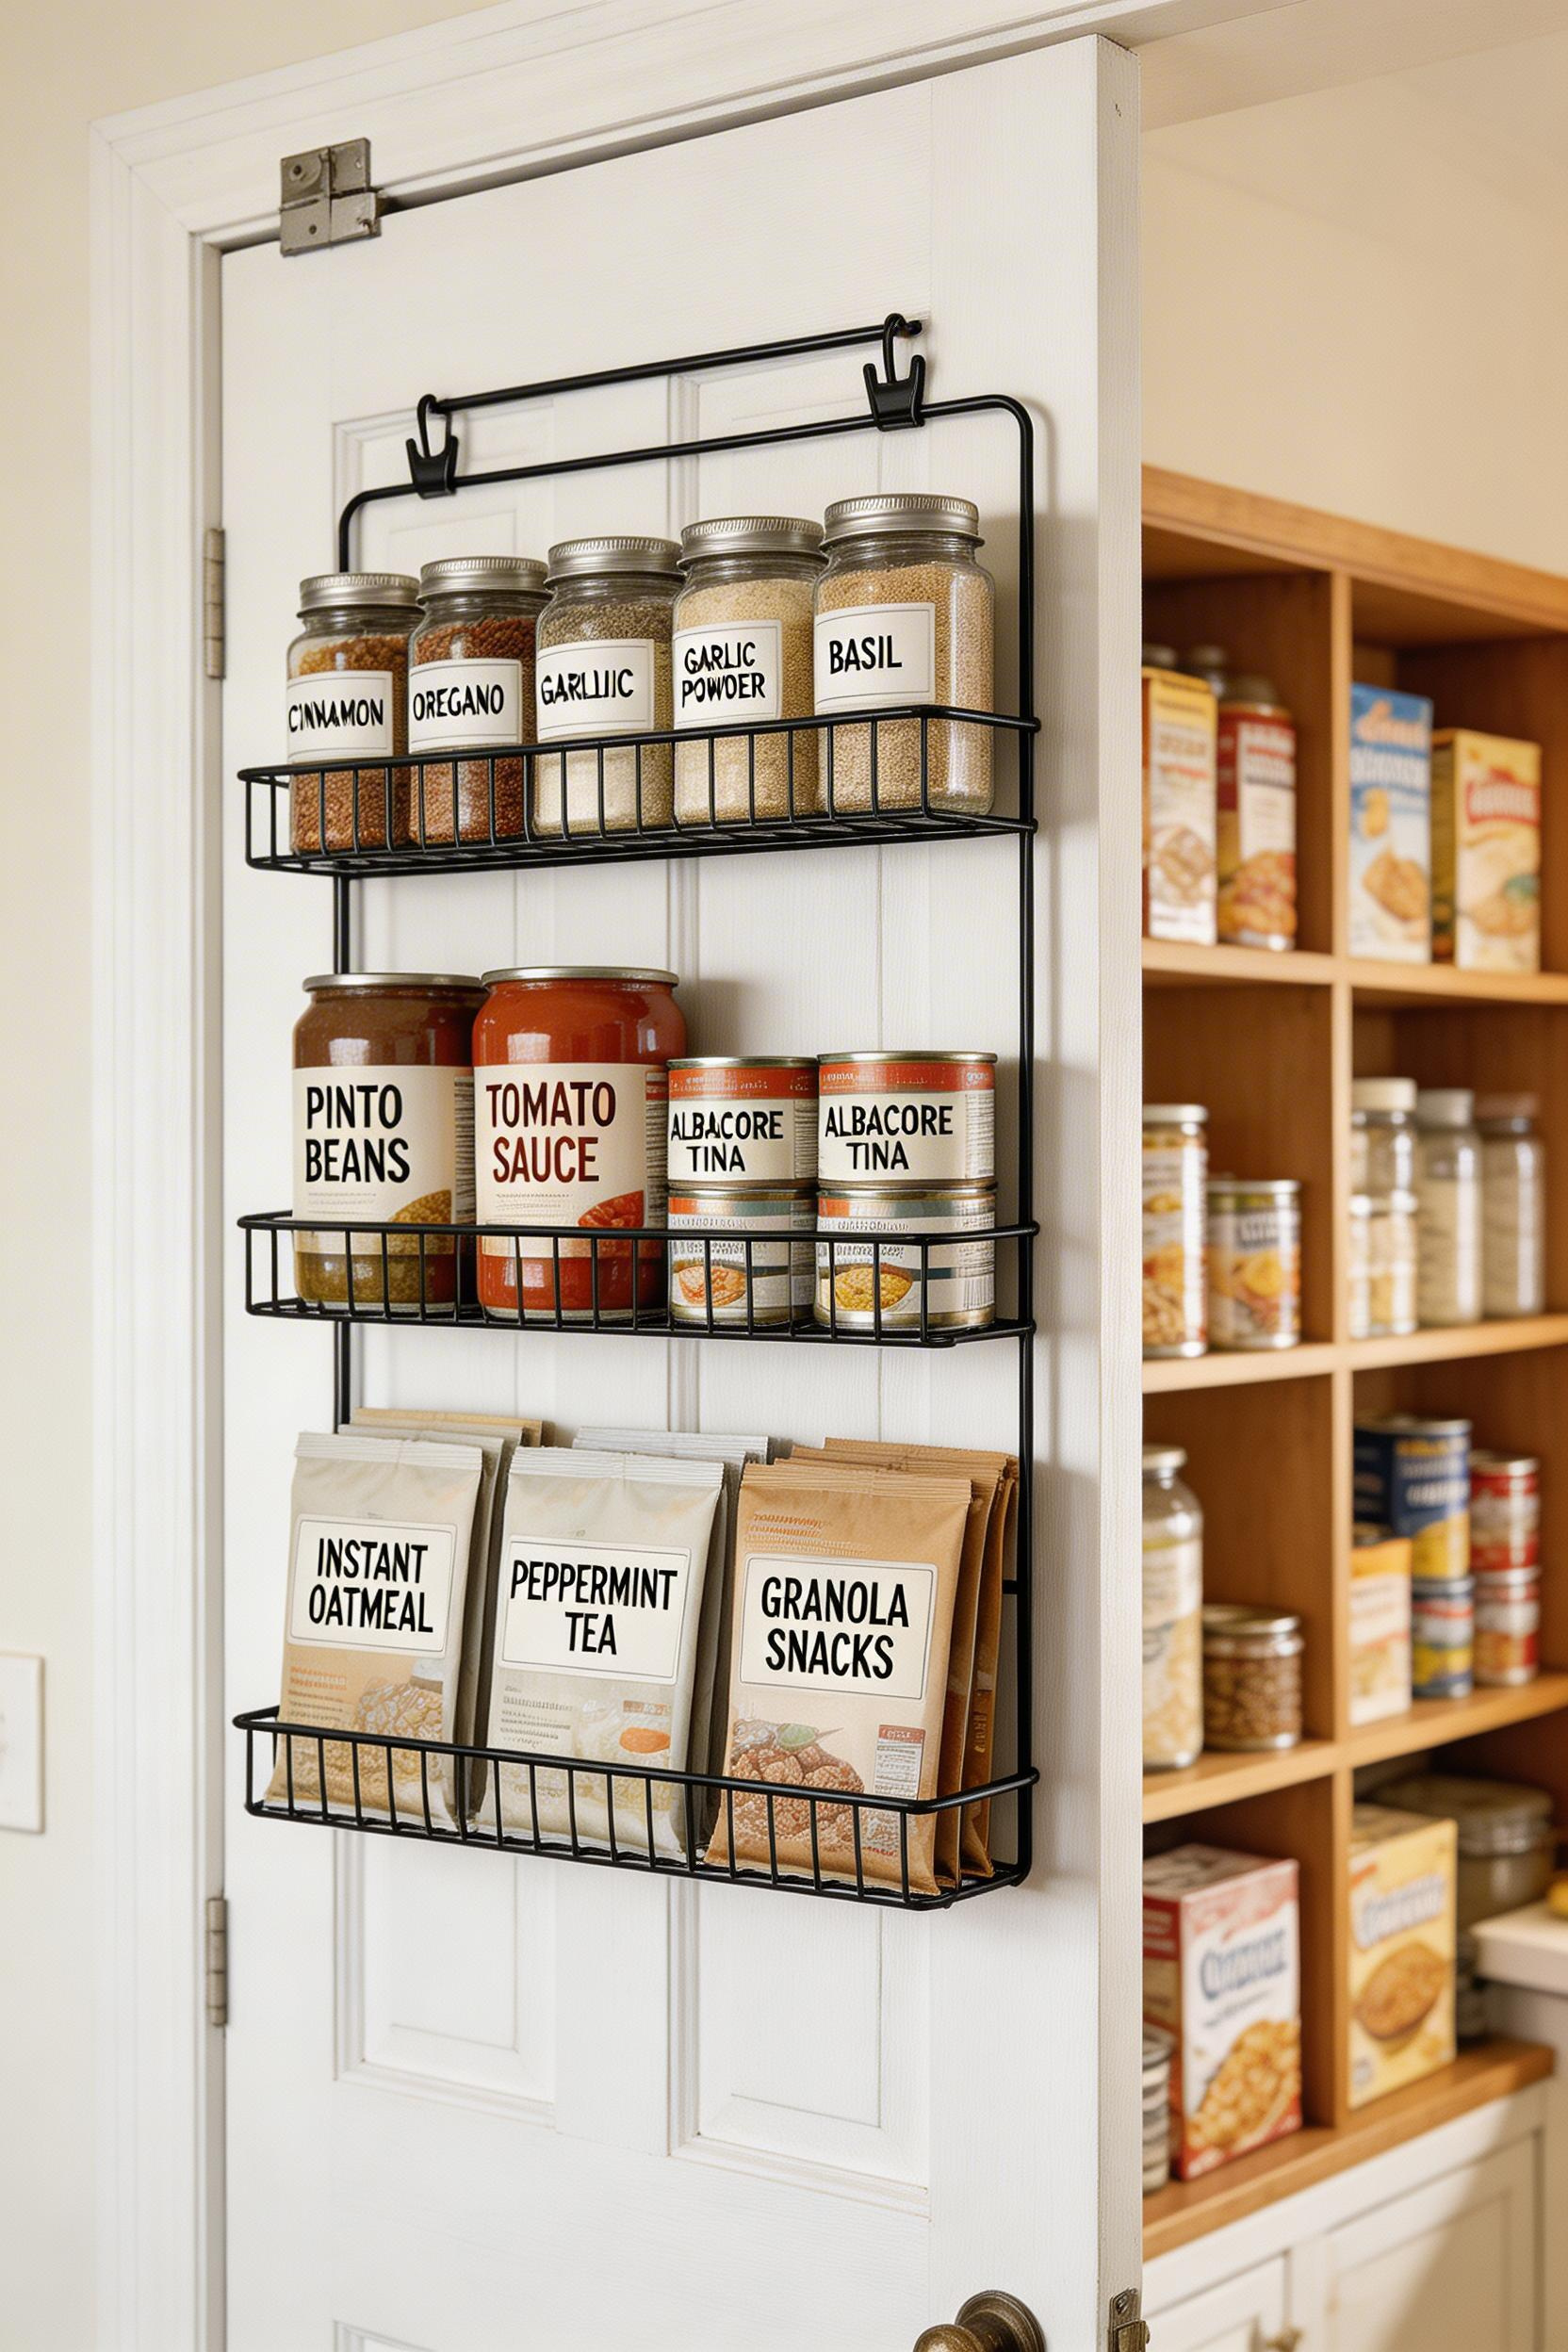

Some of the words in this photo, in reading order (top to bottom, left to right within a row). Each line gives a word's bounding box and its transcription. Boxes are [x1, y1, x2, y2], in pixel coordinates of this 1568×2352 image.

[684, 642, 757, 675] GARLIC
[829, 635, 903, 675] BASIL
[287, 698, 384, 733] CINNAMON
[413, 684, 505, 721] OREGANO
[306, 1085, 403, 1130] PINTO
[485, 1081, 617, 1128] TOMATO
[670, 1110, 784, 1141] ALBACORE
[825, 1104, 954, 1137] ALBACORE
[305, 1137, 411, 1184] BEANS
[493, 1136, 600, 1184] SAUCE
[687, 1143, 746, 1172] TINA
[846, 1140, 909, 1170] TINA
[317, 1538, 429, 1584] INSTANT
[510, 1560, 678, 1610] PEPPERMINT
[761, 1576, 909, 1627] GRANOLA
[308, 1584, 433, 1633] OATMEAL
[564, 1611, 617, 1656] TEA
[765, 1628, 894, 1679] SNACKS
